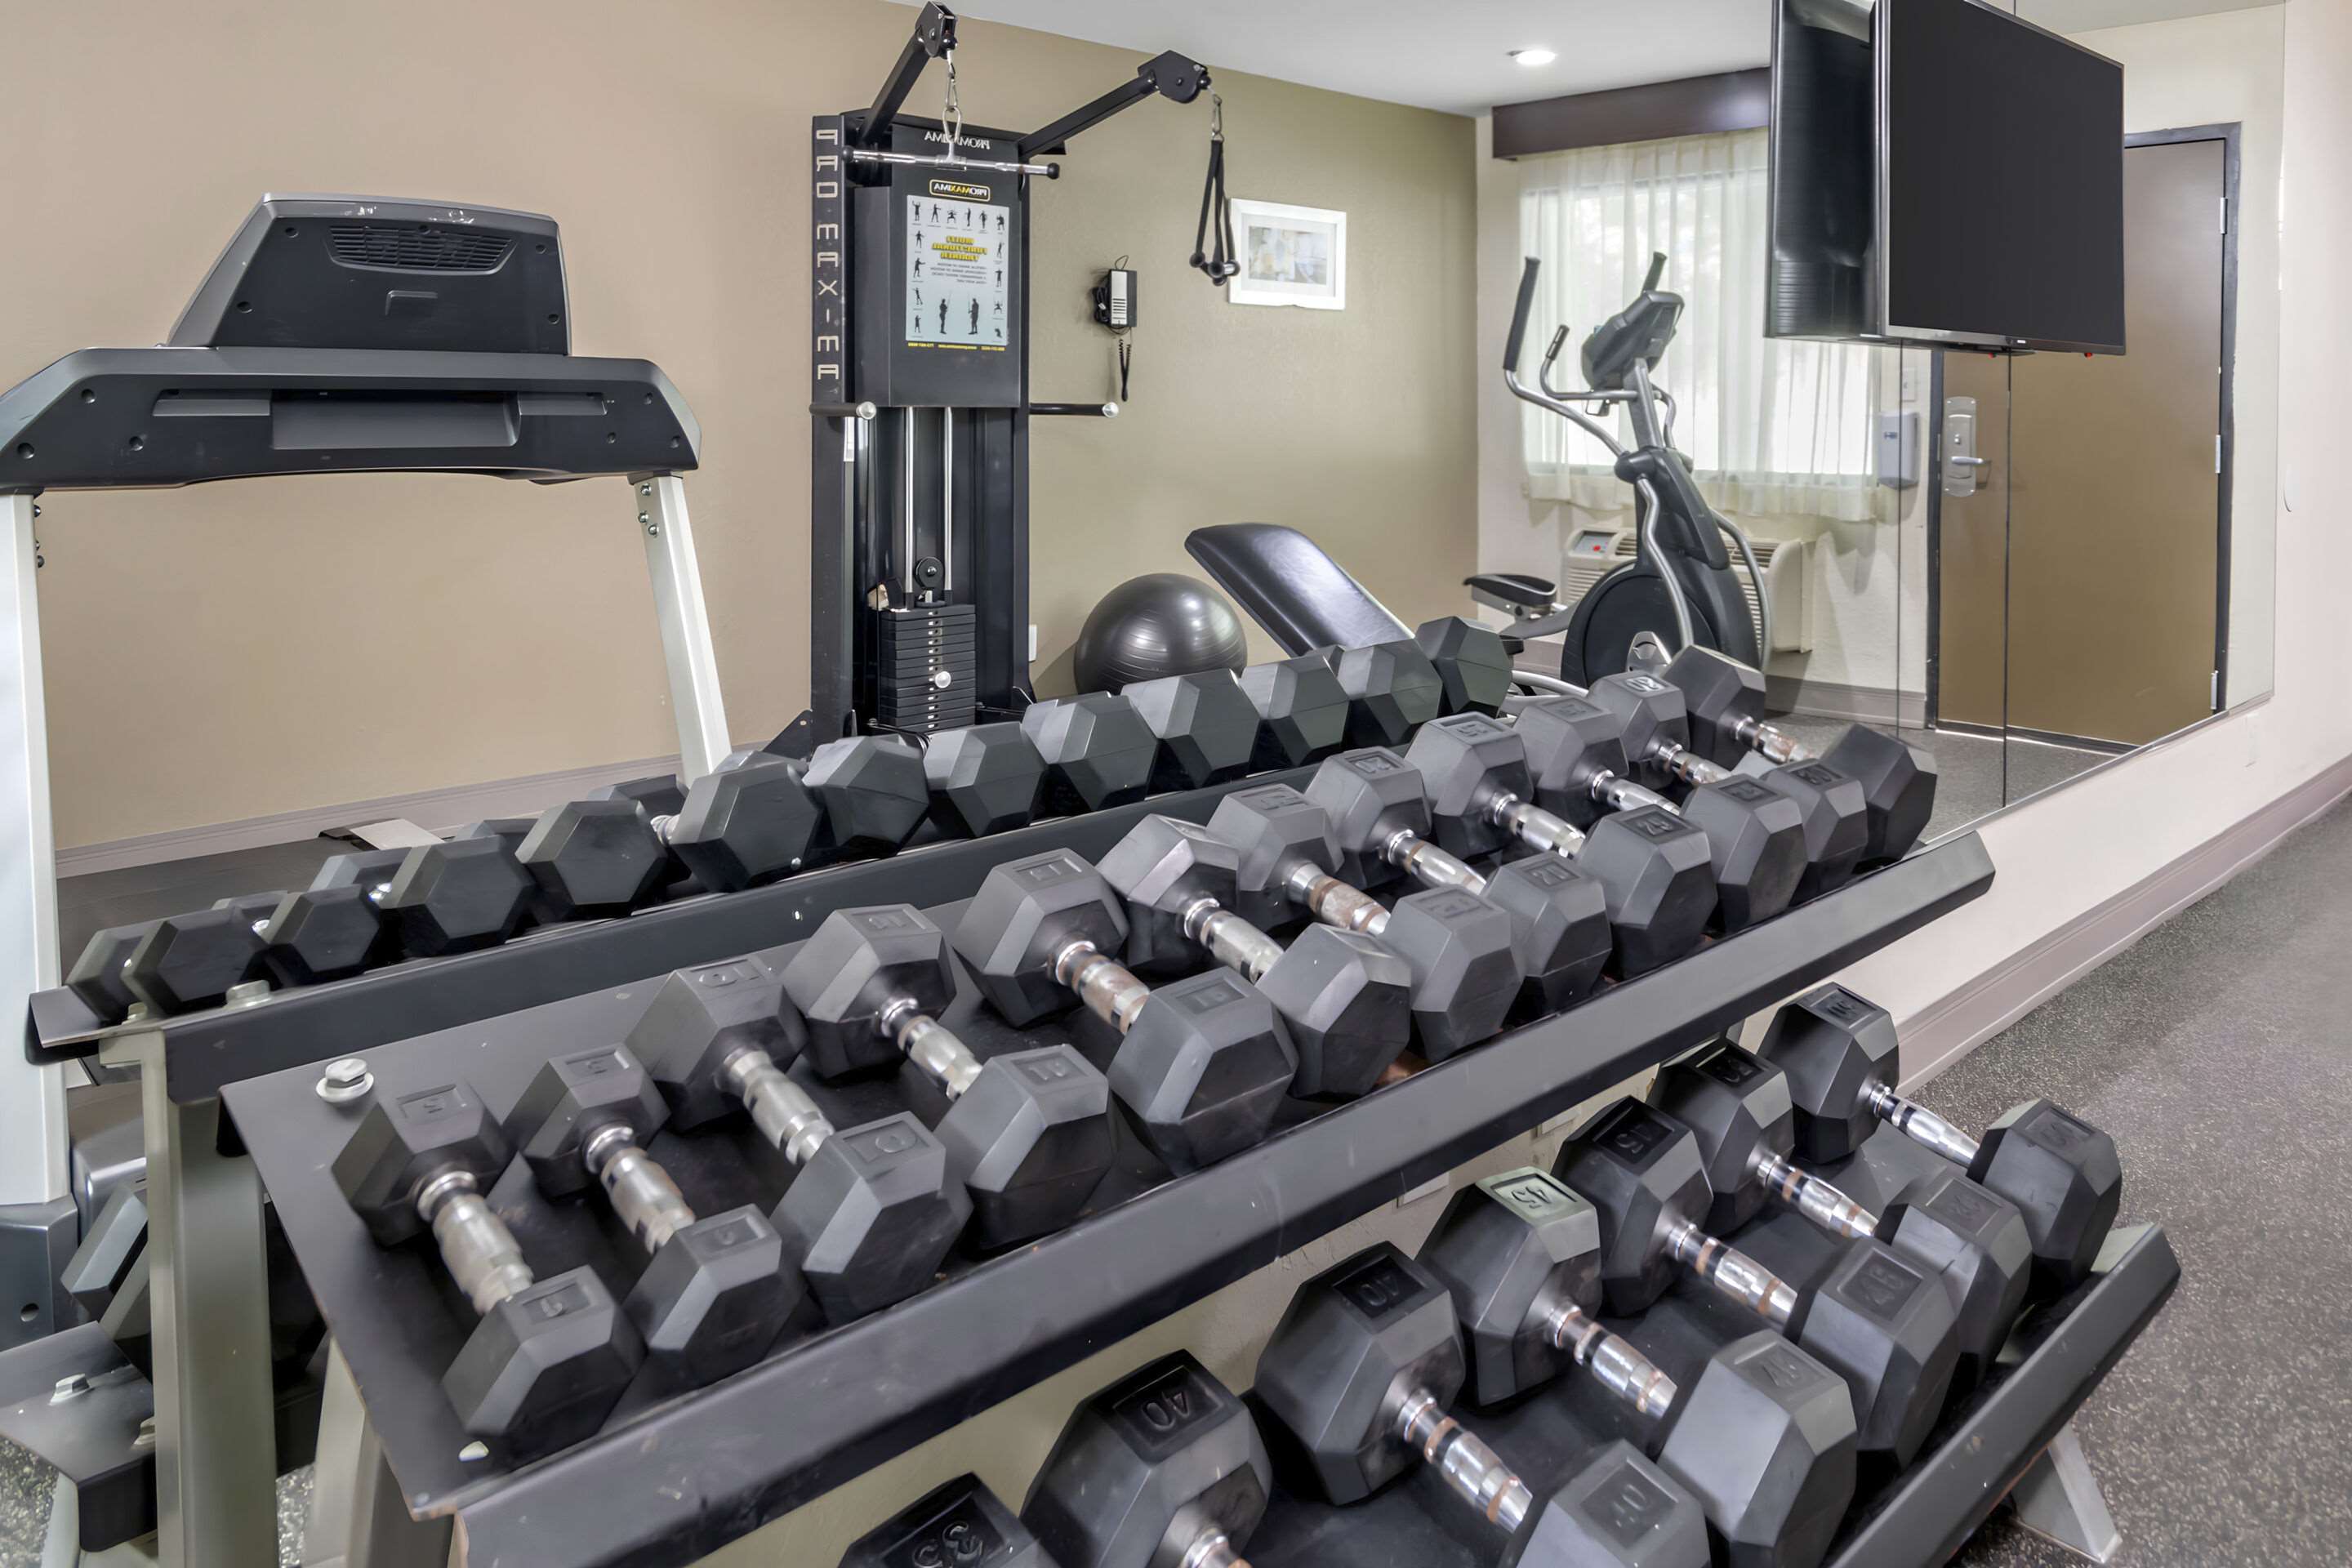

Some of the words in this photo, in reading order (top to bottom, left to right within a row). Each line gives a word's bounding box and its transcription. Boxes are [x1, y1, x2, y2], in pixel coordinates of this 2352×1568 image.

[1510, 1185, 1552, 1209] 45
[1359, 1272, 1401, 1307] 40
[1141, 1388, 1189, 1430] 40
